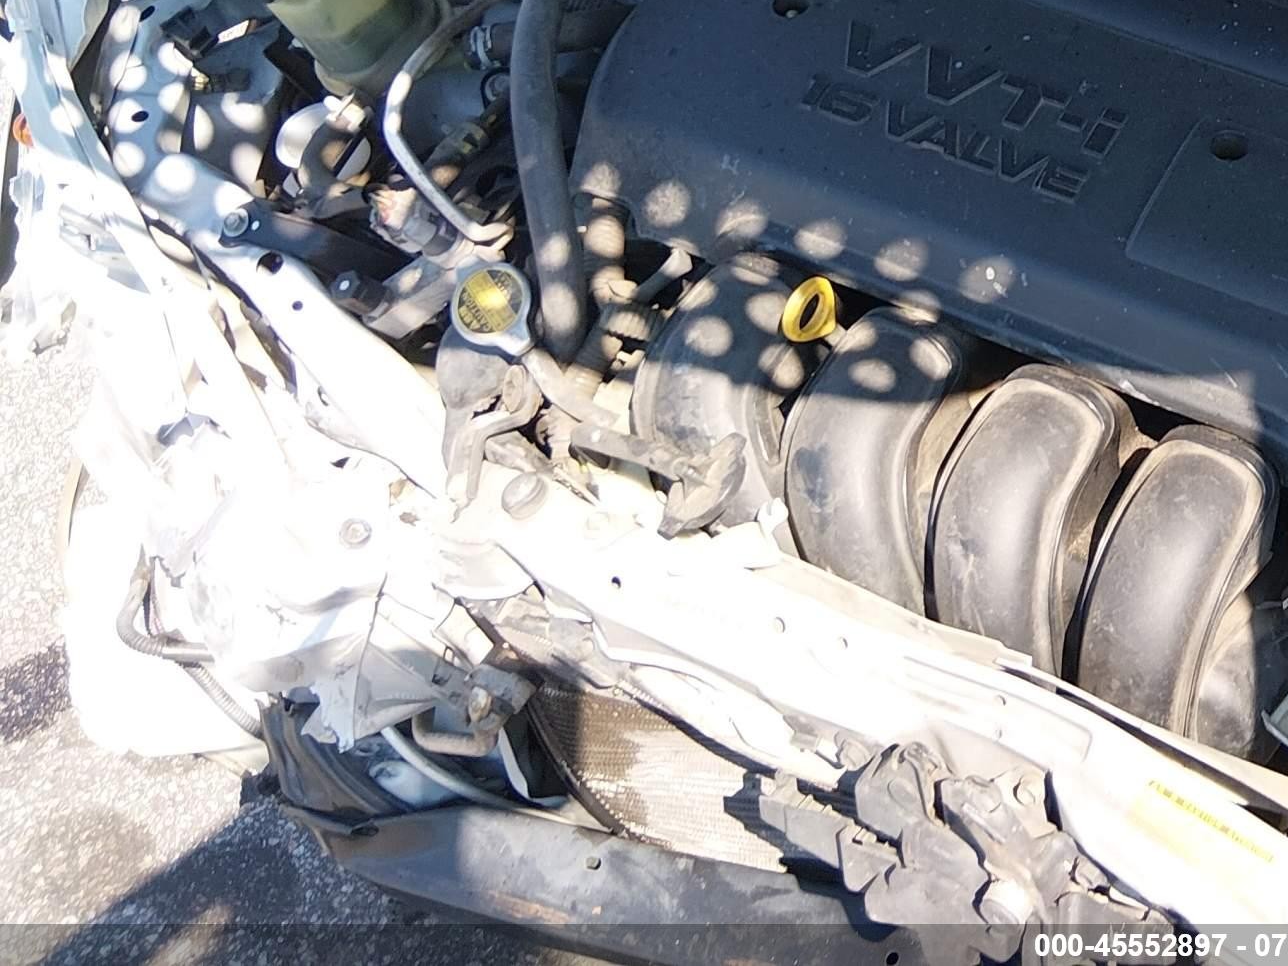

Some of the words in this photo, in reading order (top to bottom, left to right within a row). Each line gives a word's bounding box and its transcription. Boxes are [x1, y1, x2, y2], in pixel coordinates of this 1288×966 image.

[800, 72, 881, 126] 16
[886, 99, 1090, 204] VALVE
[461, 291, 492, 332] CAUTION
